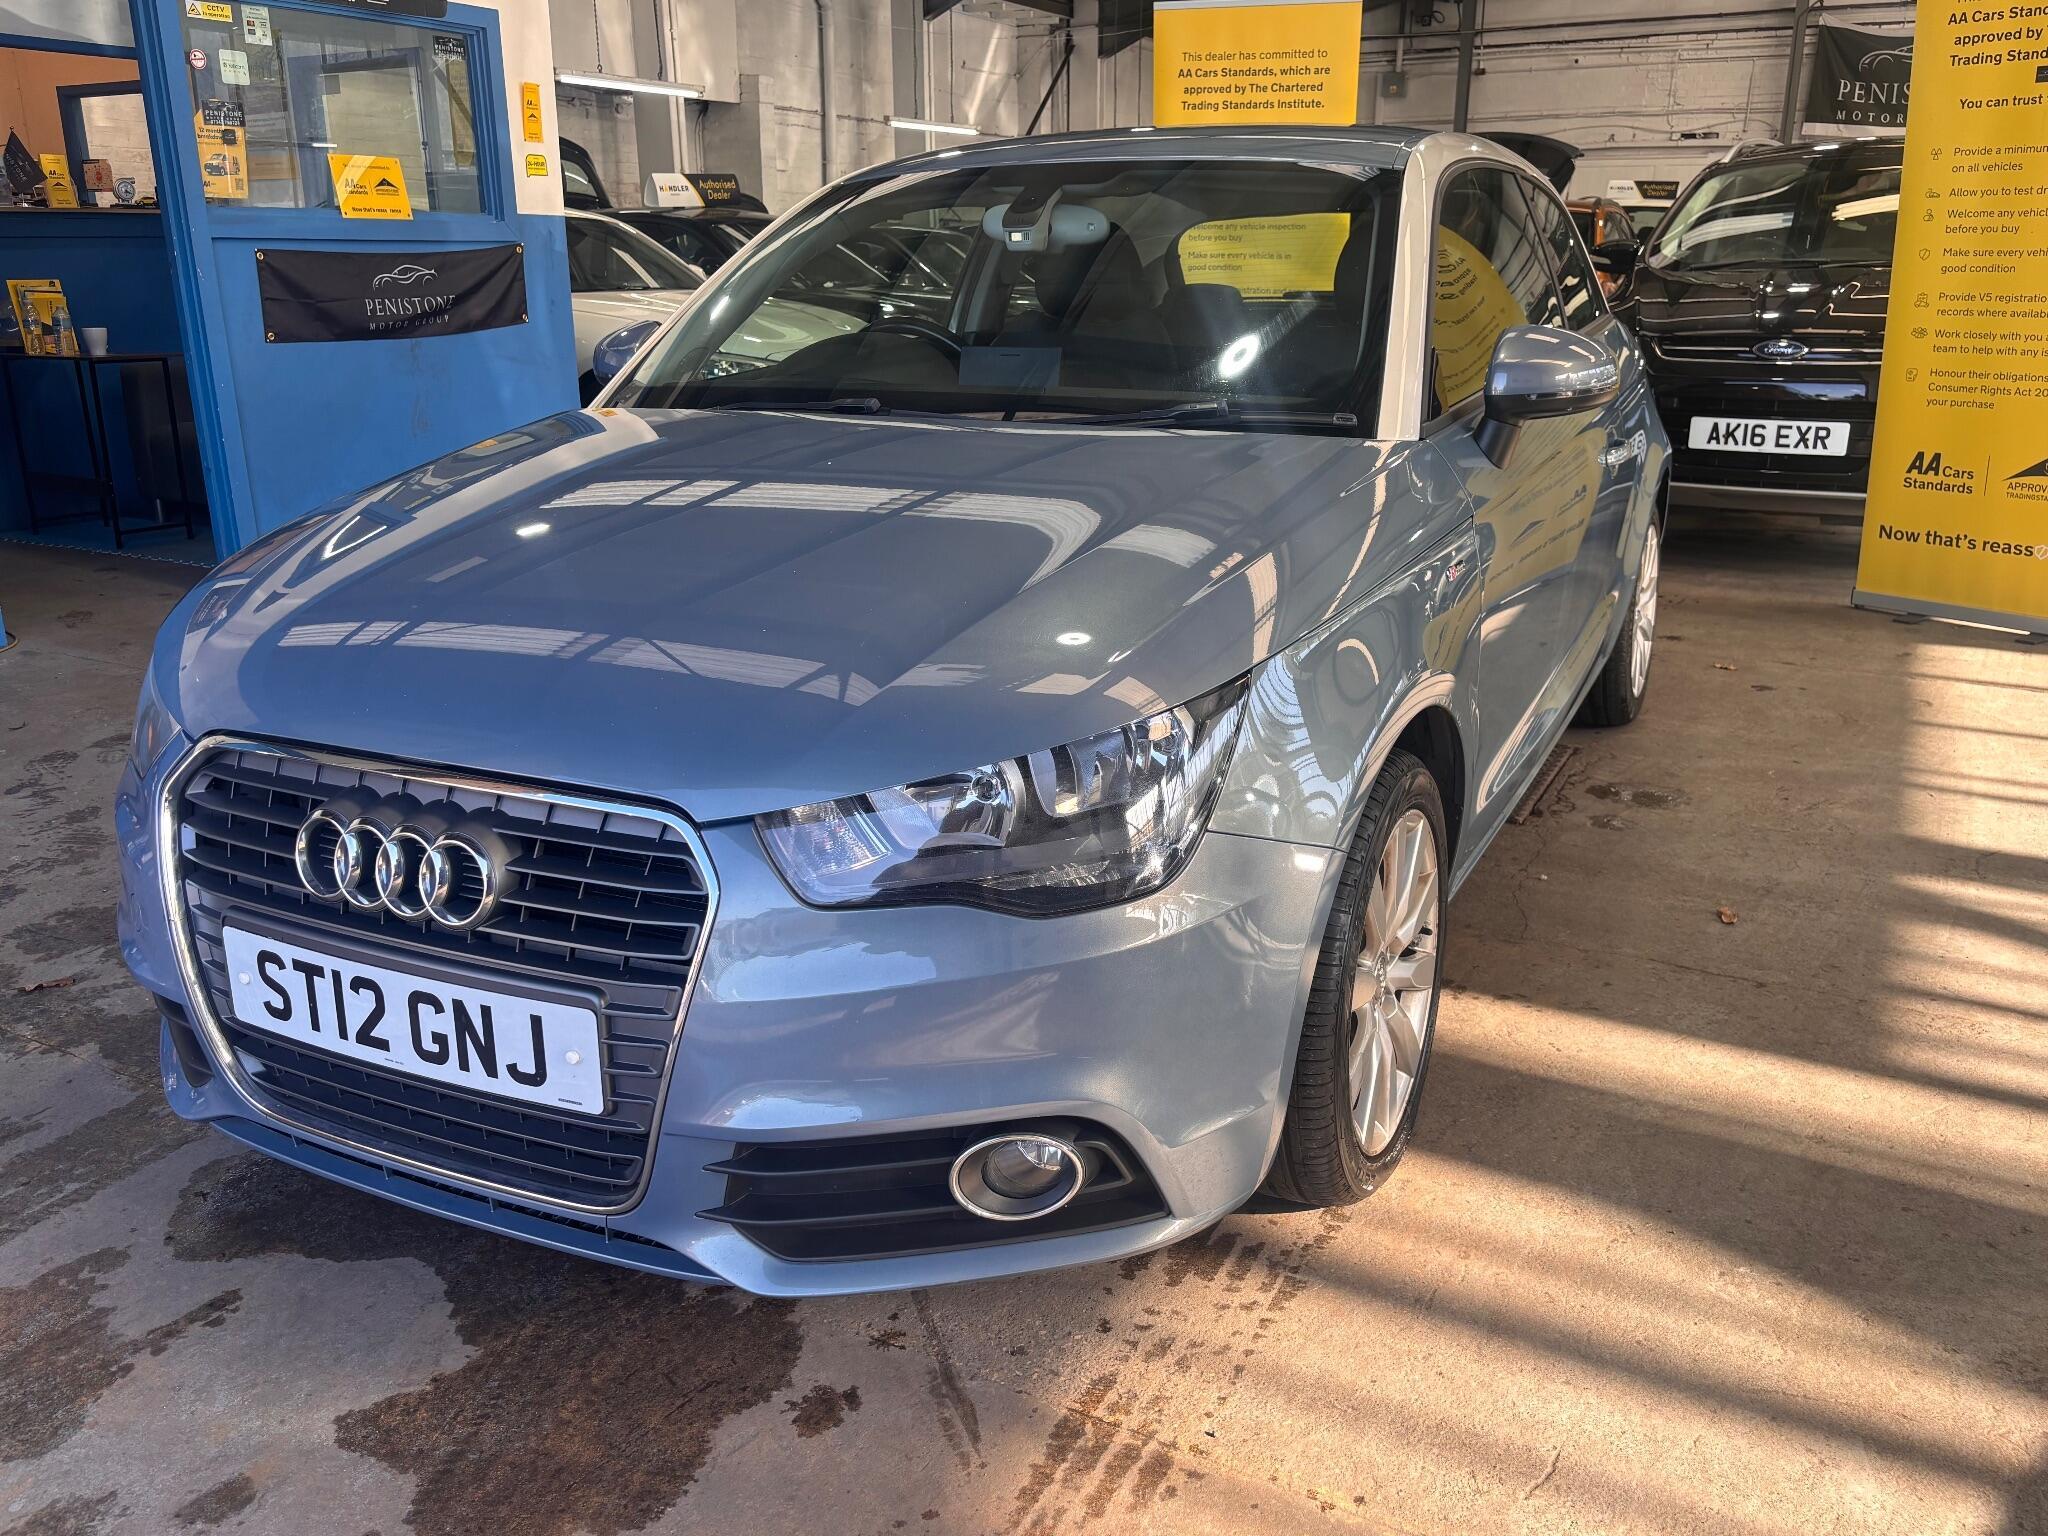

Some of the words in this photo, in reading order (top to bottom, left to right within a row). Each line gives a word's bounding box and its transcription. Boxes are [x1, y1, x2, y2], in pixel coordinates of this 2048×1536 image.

[207, 4, 225, 12] CCTV
[1948, 12, 1968, 25] AA
[1972, 10, 2005, 23] Cars
[1954, 27, 2022, 47] approved
[2026, 27, 2043, 40] by
[1182, 52, 1202, 62] This
[1204, 51, 1237, 62] dealer
[1239, 50, 1256, 61] has
[1259, 49, 1314, 61] committed
[1317, 49, 1328, 59] to
[1950, 52, 2002, 67] Trading
[1178, 68, 1193, 79] AA
[1195, 68, 1218, 79] Cars
[1221, 66, 1277, 77] Standards,
[1279, 65, 1311, 76] which
[1313, 66, 1331, 76] are
[1183, 83, 1232, 96] approved
[1234, 83, 1247, 96] by
[1248, 83, 1268, 94] The
[1270, 82, 1324, 93] Chartered
[1181, 100, 1219, 112] Trading
[1222, 99, 1275, 110] Standards
[1277, 98, 1325, 110] Institute.
[1960, 98, 1982, 110] You
[1986, 98, 2009, 108] can
[2012, 94, 2044, 106] trust
[204, 109, 243, 119] PENISTONE
[1836, 110, 1904, 123] MOTOR
[1953, 146, 1993, 157] Provide
[1995, 147, 2002, 155] a
[1951, 165, 1965, 173] on
[1967, 163, 1980, 172] all
[1982, 161, 2024, 172] vehicles
[344, 178, 356, 189] AA
[659, 183, 690, 193] HANDLER
[699, 179, 736, 190] Authorised
[707, 190, 731, 200] Dealer
[1949, 187, 1978, 197] Allow
[1980, 189, 1999, 198] you
[2001, 187, 2011, 196] to
[2014, 186, 2033, 196] test
[1947, 209, 1995, 219] Welcome
[1997, 209, 2016, 220] any
[1224, 224, 1238, 232] any
[1239, 223, 1266, 231] vehicle
[1267, 223, 1307, 232] inspection
[1945, 224, 1978, 234] before
[1980, 225, 1999, 235] you
[2001, 224, 2020, 235] buy
[1188, 234, 1213, 242] before
[1213, 235, 1228, 243] you
[1229, 234, 1243, 243] buy
[1187, 251, 1208, 259] Make
[1227, 252, 1248, 261] every
[1248, 252, 1275, 260] vehicle
[1943, 247, 1970, 257] Make
[1972, 249, 1994, 257] sure
[1996, 249, 2024, 259] every
[1187, 264, 1207, 272] good
[1941, 264, 1967, 274] good
[1969, 264, 2016, 273] condition
[1938, 292, 1976, 302] Provide
[1979, 292, 1993, 302] V5
[365, 295, 456, 316] PENISTONE
[1936, 307, 1974, 317] records
[1976, 308, 2007, 318] where
[369, 320, 409, 331] MOTOR
[1934, 328, 1961, 339] Work
[1963, 330, 1998, 341] closely
[1999, 331, 2021, 341] with
[2023, 333, 2043, 343] you
[1933, 344, 1957, 354] team
[1960, 345, 1970, 354] to
[1972, 345, 1993, 356] help
[1995, 346, 2017, 356] with
[2020, 348, 2039, 358] any
[1930, 368, 1967, 379] Honour
[1968, 370, 1991, 380] their
[1993, 371, 2048, 382] obligations
[1928, 382, 1978, 394] Consumer
[1980, 385, 2012, 397] Rights
[2014, 387, 2032, 397] Act
[1926, 398, 1949, 408] your
[1950, 399, 1995, 410] purchase
[1706, 422, 1767, 447] AK16
[1774, 425, 1831, 450] EXR
[1905, 451, 1942, 477] AA
[1942, 465, 1974, 480] Cars
[1903, 477, 1973, 495] Standards
[1878, 524, 1920, 543] Now
[1925, 529, 1977, 550] that's
[256, 949, 391, 1053] ST12
[406, 989, 549, 1088] GNJ
